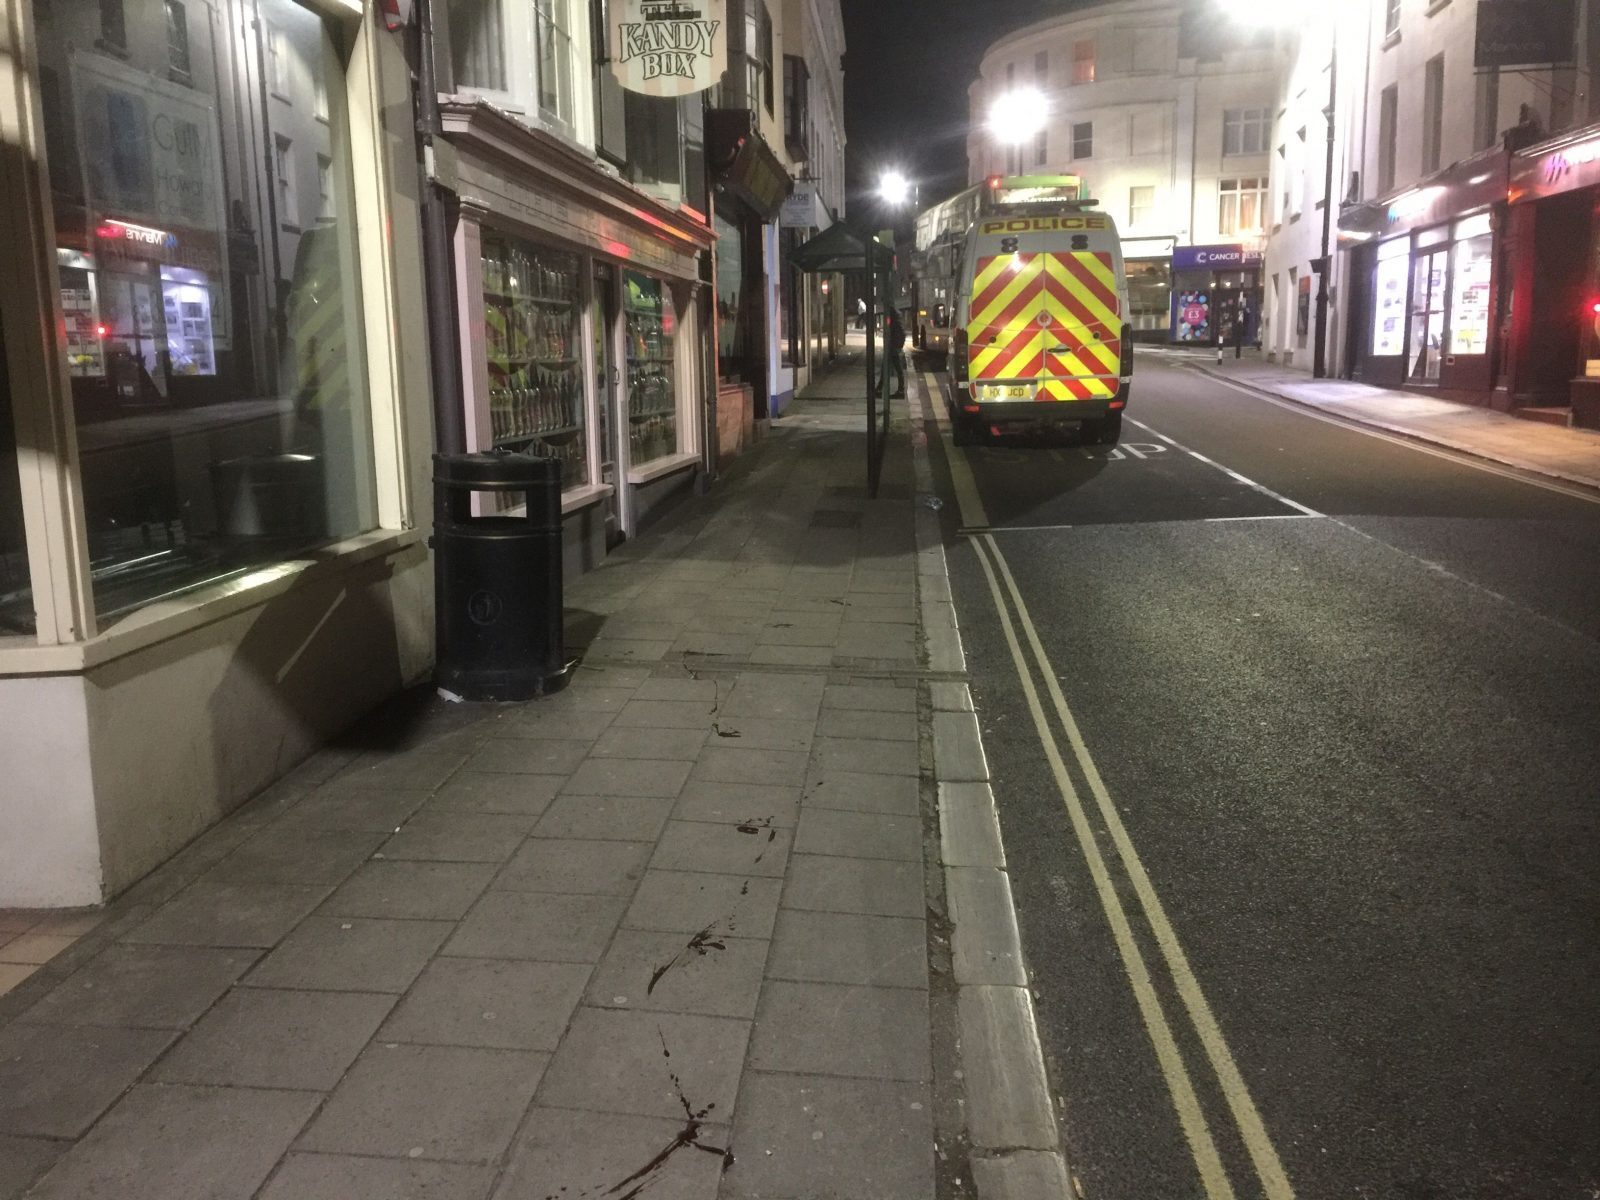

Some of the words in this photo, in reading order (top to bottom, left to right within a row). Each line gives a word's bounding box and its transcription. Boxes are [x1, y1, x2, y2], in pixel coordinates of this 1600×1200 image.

[618, 20, 720, 63] KANDY
[642, 51, 697, 80] BOX
[984, 217, 1105, 233] POLICE
[1209, 252, 1240, 260] CANCER
[1188, 310, 1200, 319] £3
